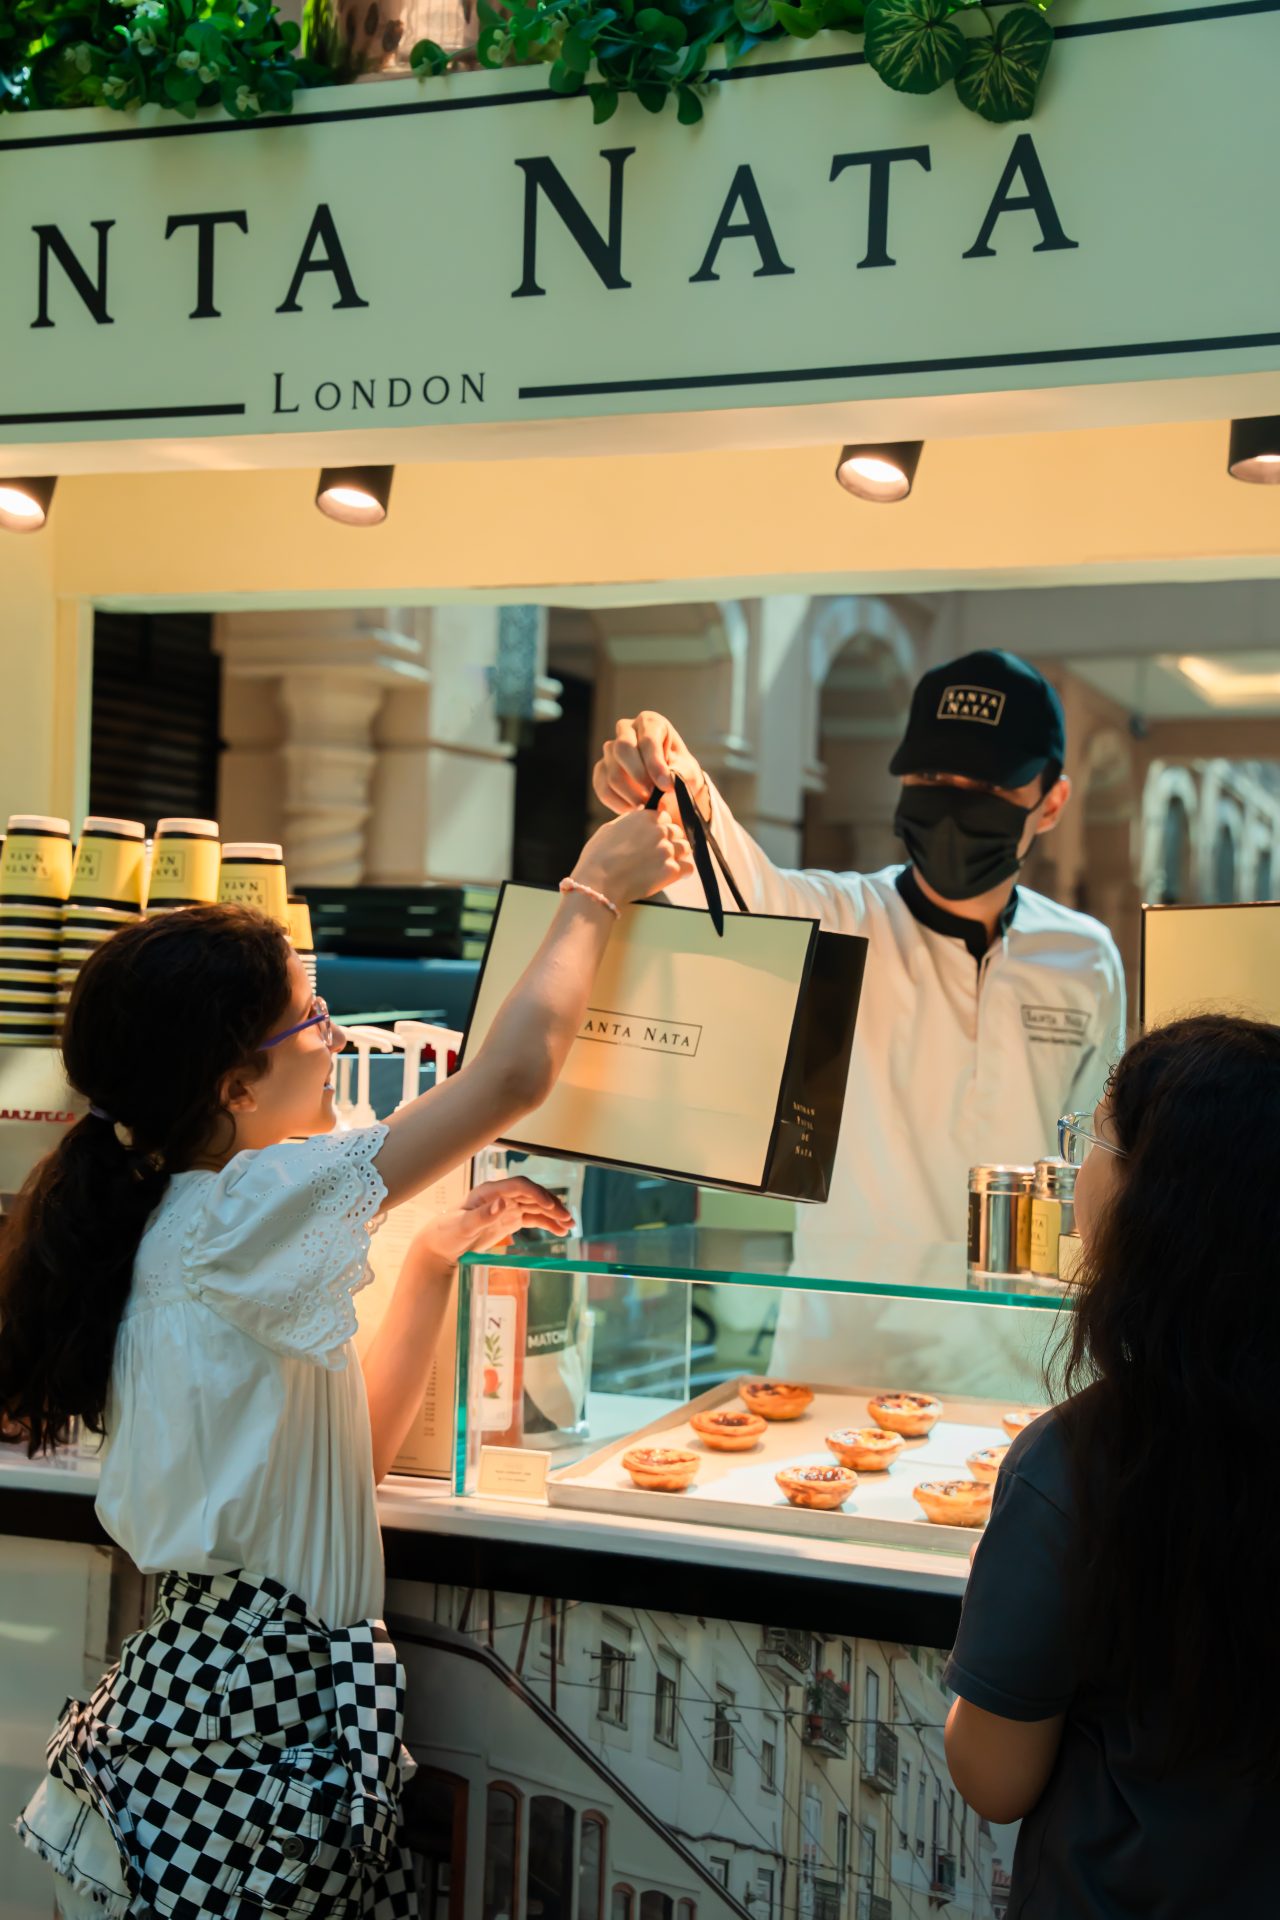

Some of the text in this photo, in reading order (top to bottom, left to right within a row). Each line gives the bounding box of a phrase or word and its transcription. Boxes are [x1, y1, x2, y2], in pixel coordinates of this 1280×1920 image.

[30, 133, 1079, 329] NTA NATA
[272, 371, 486, 414] LONDON
[946, 690, 998, 708] SANTA
[947, 702, 989, 718] NATA
[583, 1020, 690, 1047] ANTA NATA
